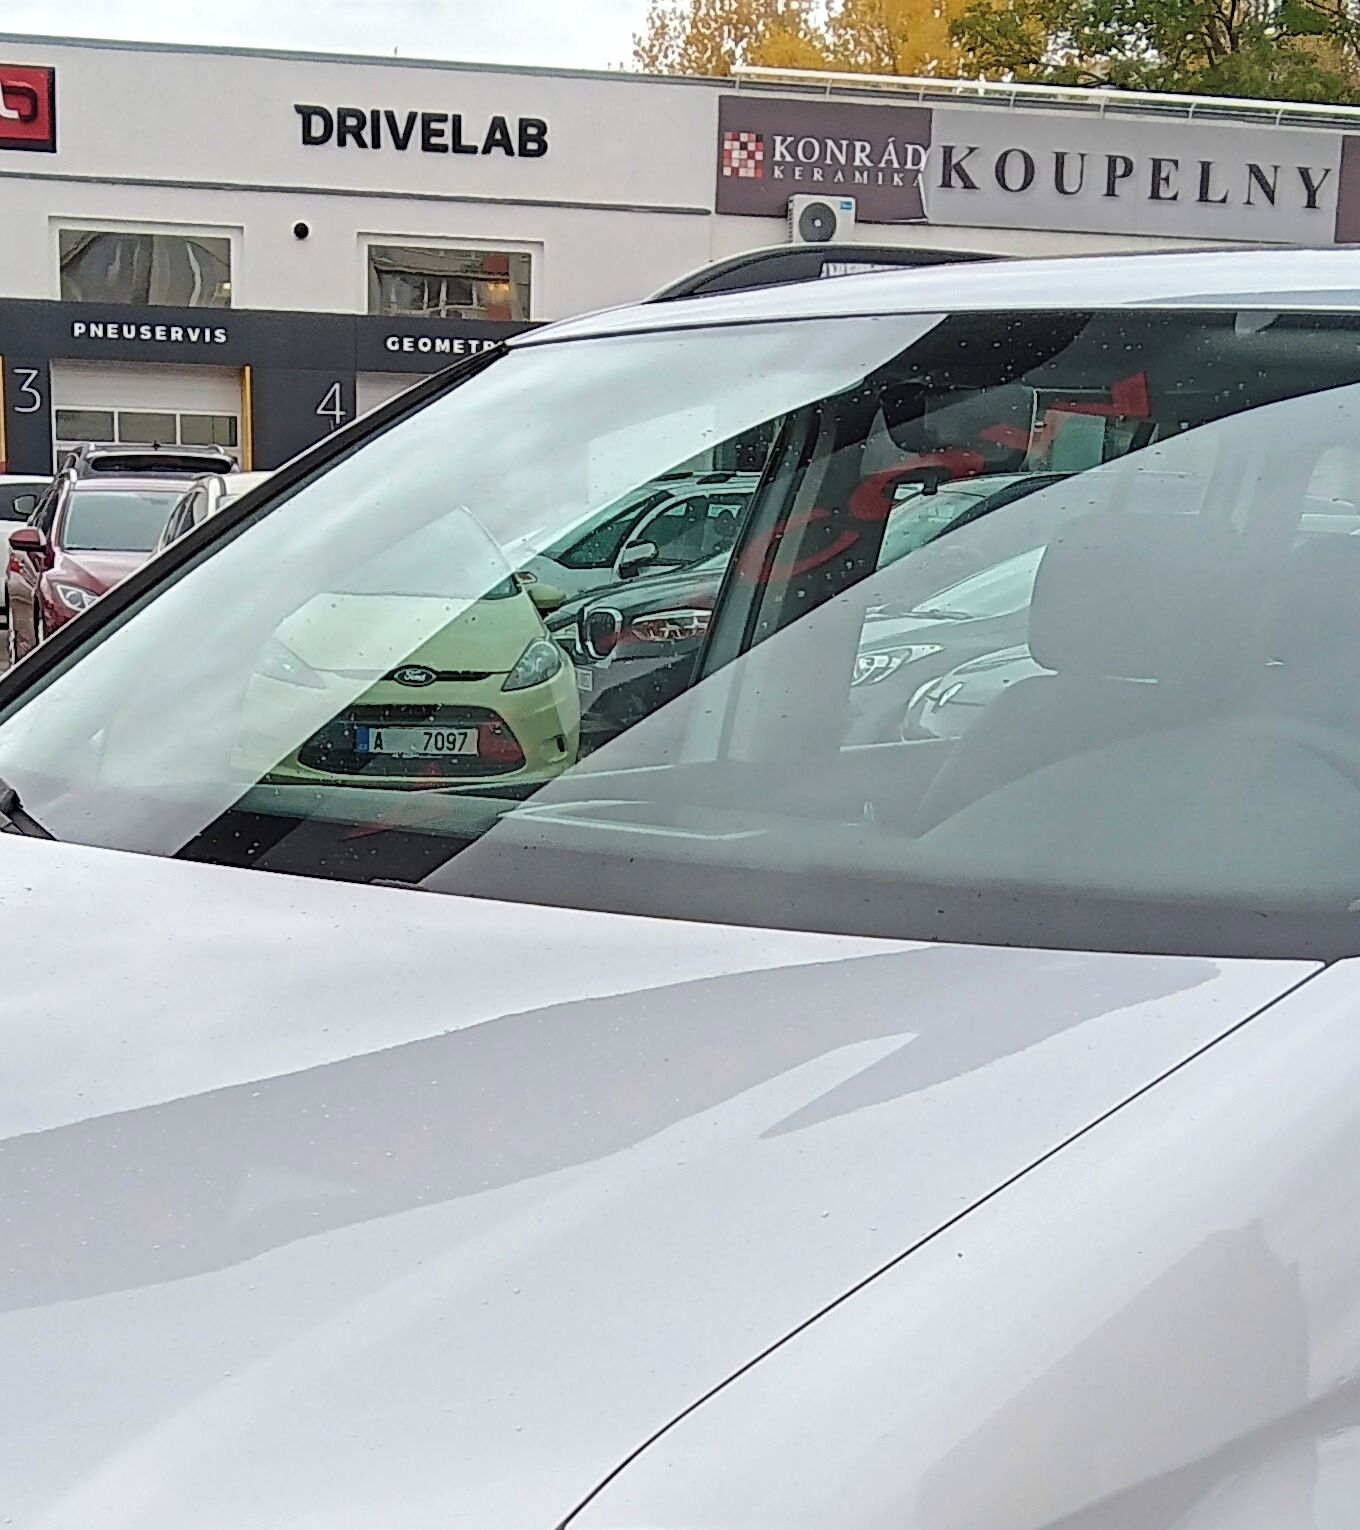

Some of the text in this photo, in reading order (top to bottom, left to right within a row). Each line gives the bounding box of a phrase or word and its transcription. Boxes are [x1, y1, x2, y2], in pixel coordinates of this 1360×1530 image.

[293, 103, 549, 158] DRIVELAB
[772, 135, 929, 171] KONRÁD
[937, 144, 1333, 210] KOUPELNY
[72, 322, 228, 343] PNEUSERVIS
[13, 368, 41, 413] 3
[316, 382, 346, 425] 4
[423, 731, 468, 752] 7097
